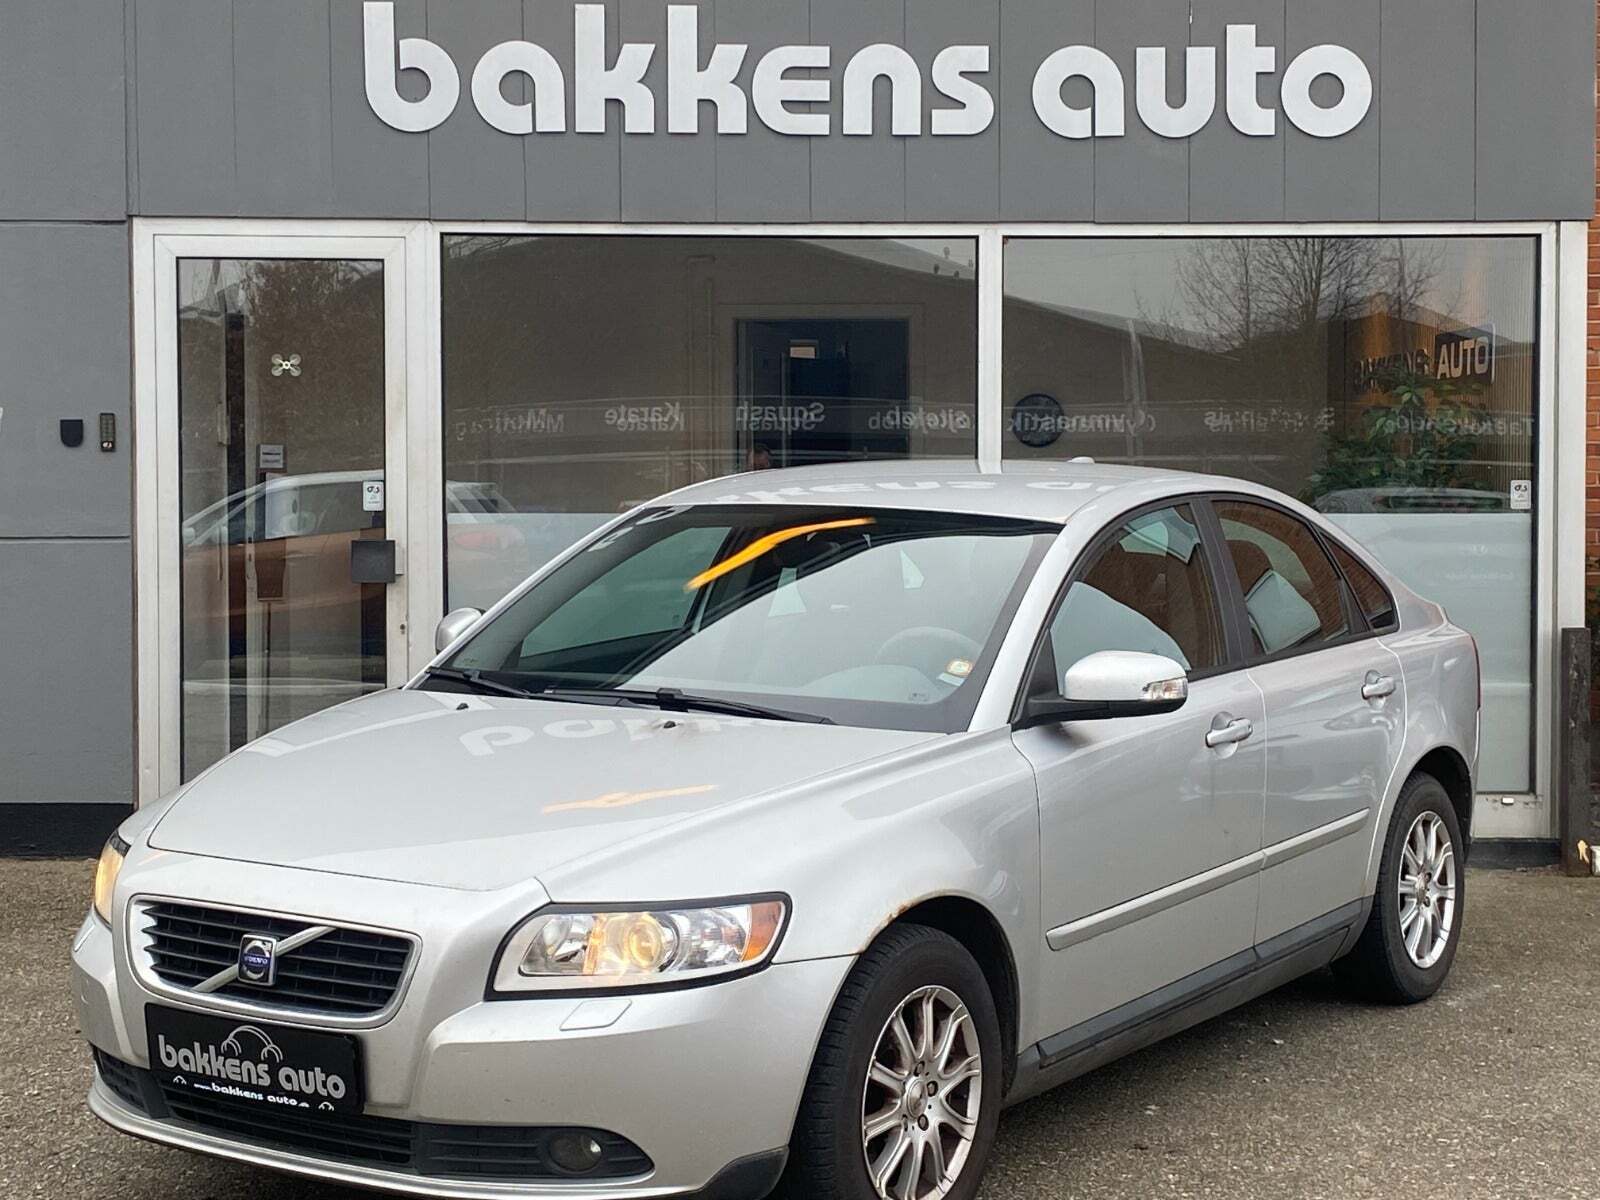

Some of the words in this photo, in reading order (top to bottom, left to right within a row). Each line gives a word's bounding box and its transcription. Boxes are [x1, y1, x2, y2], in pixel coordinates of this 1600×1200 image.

[363, 1, 995, 135] bakkens
[1032, 23, 1373, 138] auto
[1437, 336, 1489, 380] AUTO
[158, 1034, 271, 1087] bakkens
[278, 1066, 346, 1099] auto
